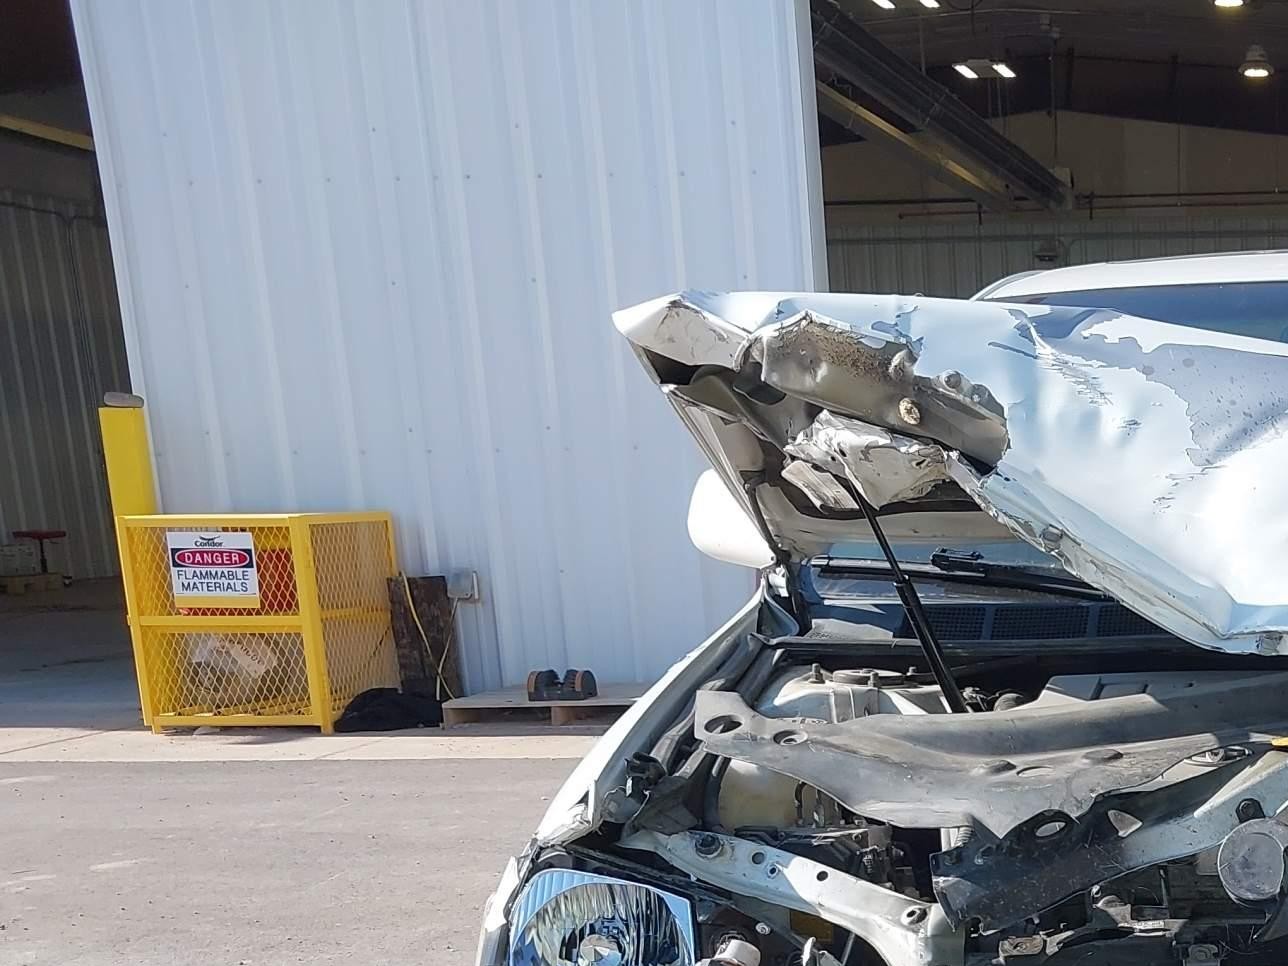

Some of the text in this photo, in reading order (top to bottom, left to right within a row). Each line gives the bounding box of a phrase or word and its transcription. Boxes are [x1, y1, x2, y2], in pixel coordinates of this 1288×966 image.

[194, 539, 224, 548] Condor
[184, 552, 240, 564] DANGER
[176, 569, 250, 581] FLAMMABLE
[181, 581, 249, 593] MATERIALS
